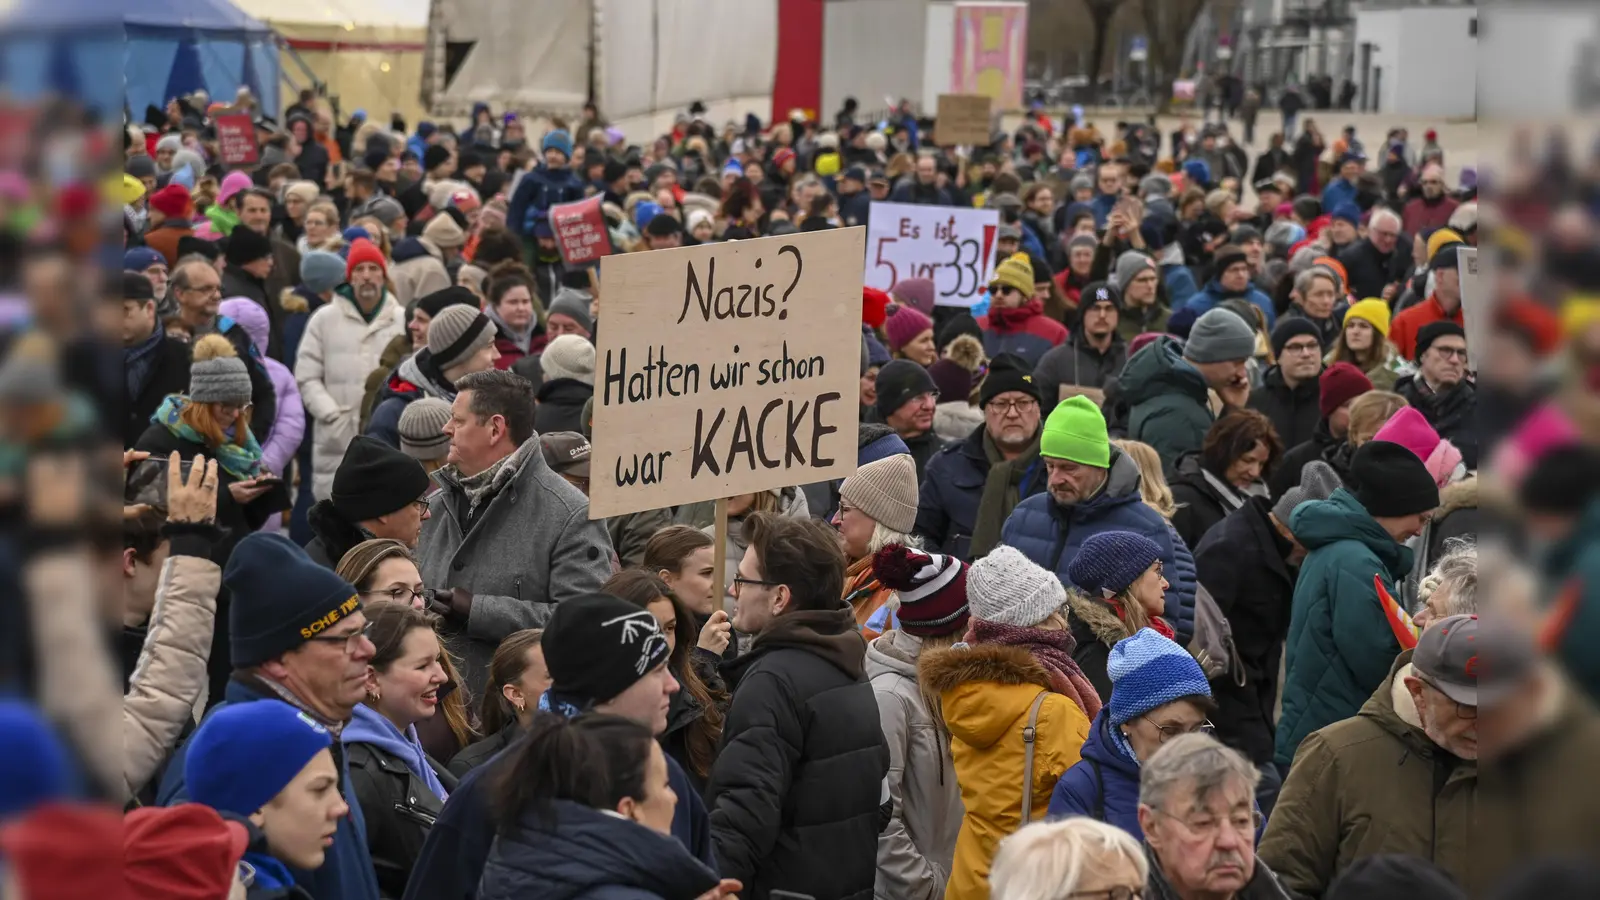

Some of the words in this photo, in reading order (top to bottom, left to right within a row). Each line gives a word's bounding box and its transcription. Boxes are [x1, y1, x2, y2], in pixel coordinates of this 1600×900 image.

[899, 217, 921, 240] Es
[934, 214, 958, 241] ist
[677, 244, 803, 324] Nazis?
[875, 237, 898, 294] 5
[603, 344, 700, 406] Hatten
[709, 344, 751, 390] wir
[756, 340, 825, 386] schon
[615, 450, 672, 487] war
[690, 391, 842, 480] KACKE
